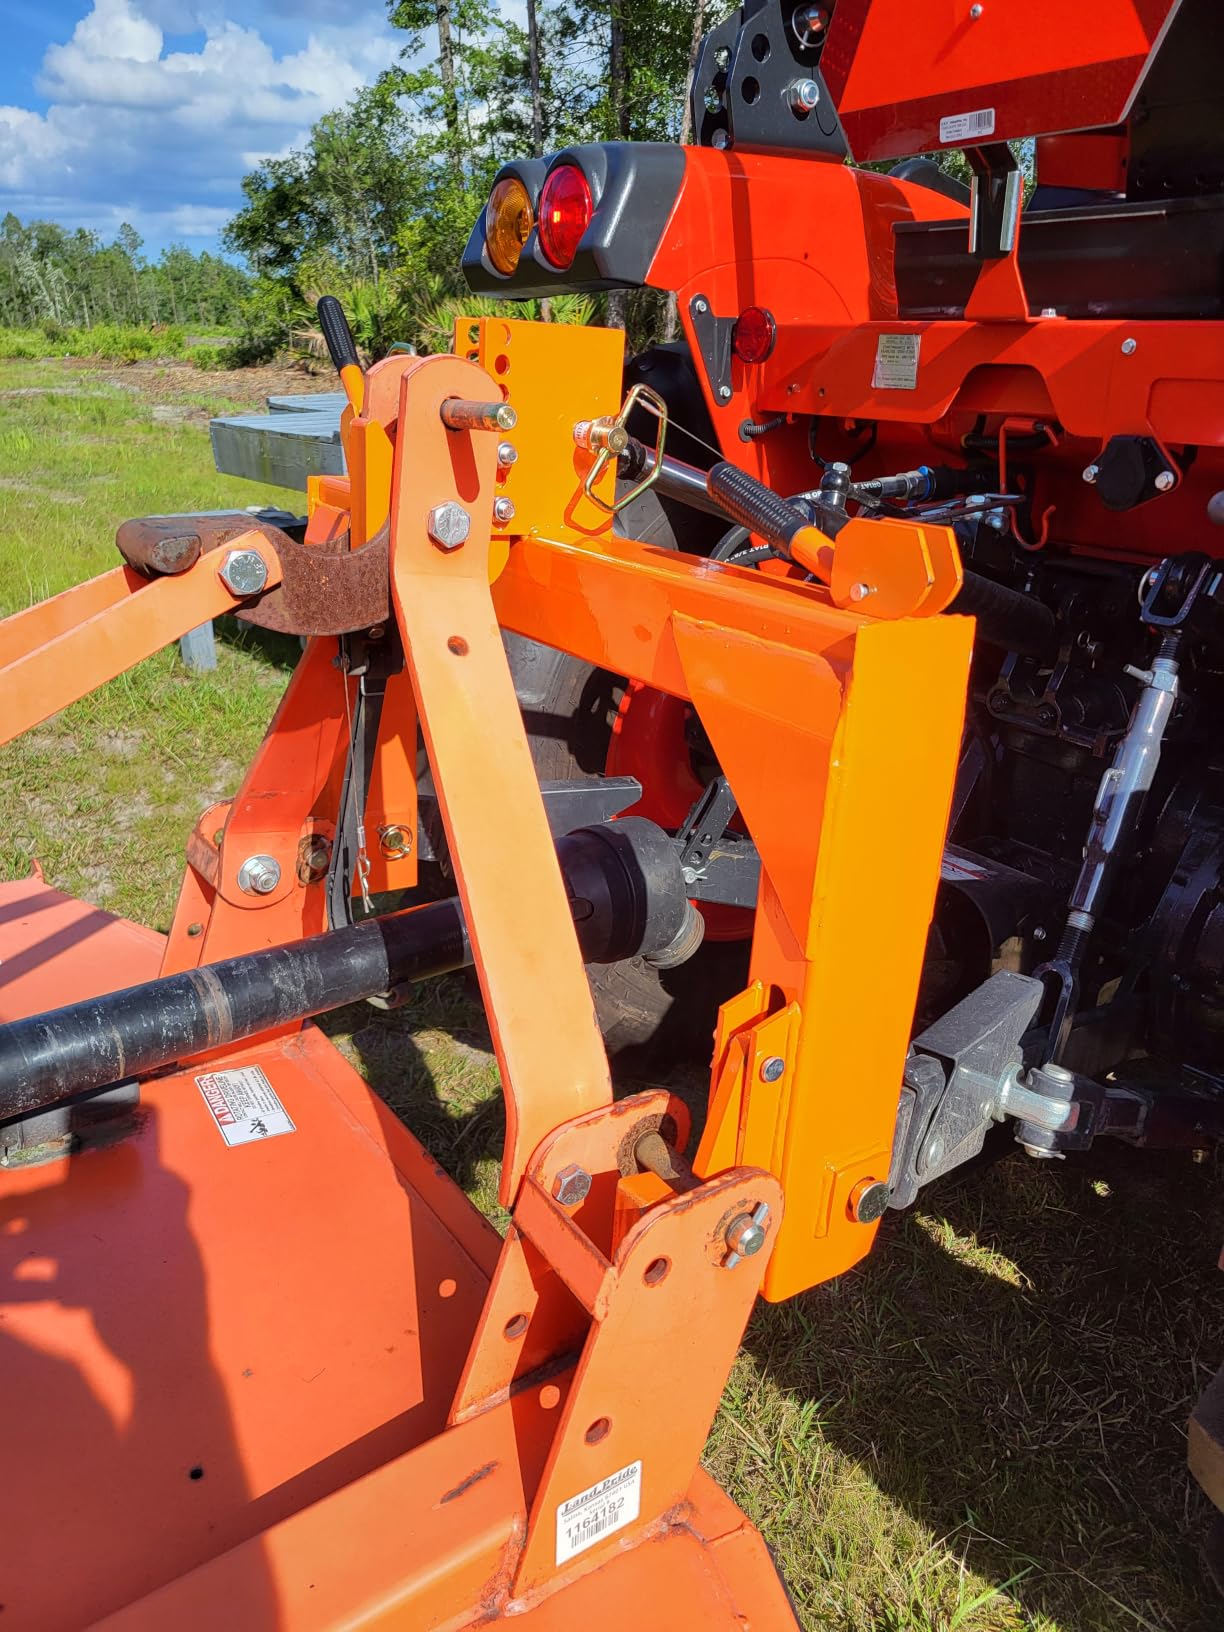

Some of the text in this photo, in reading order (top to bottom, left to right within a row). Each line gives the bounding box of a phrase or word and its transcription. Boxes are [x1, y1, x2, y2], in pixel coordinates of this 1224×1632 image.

[199, 1075, 230, 1114] DANGER
[227, 1098, 242, 1120] ROTATING
[566, 1496, 625, 1538] 1164182
